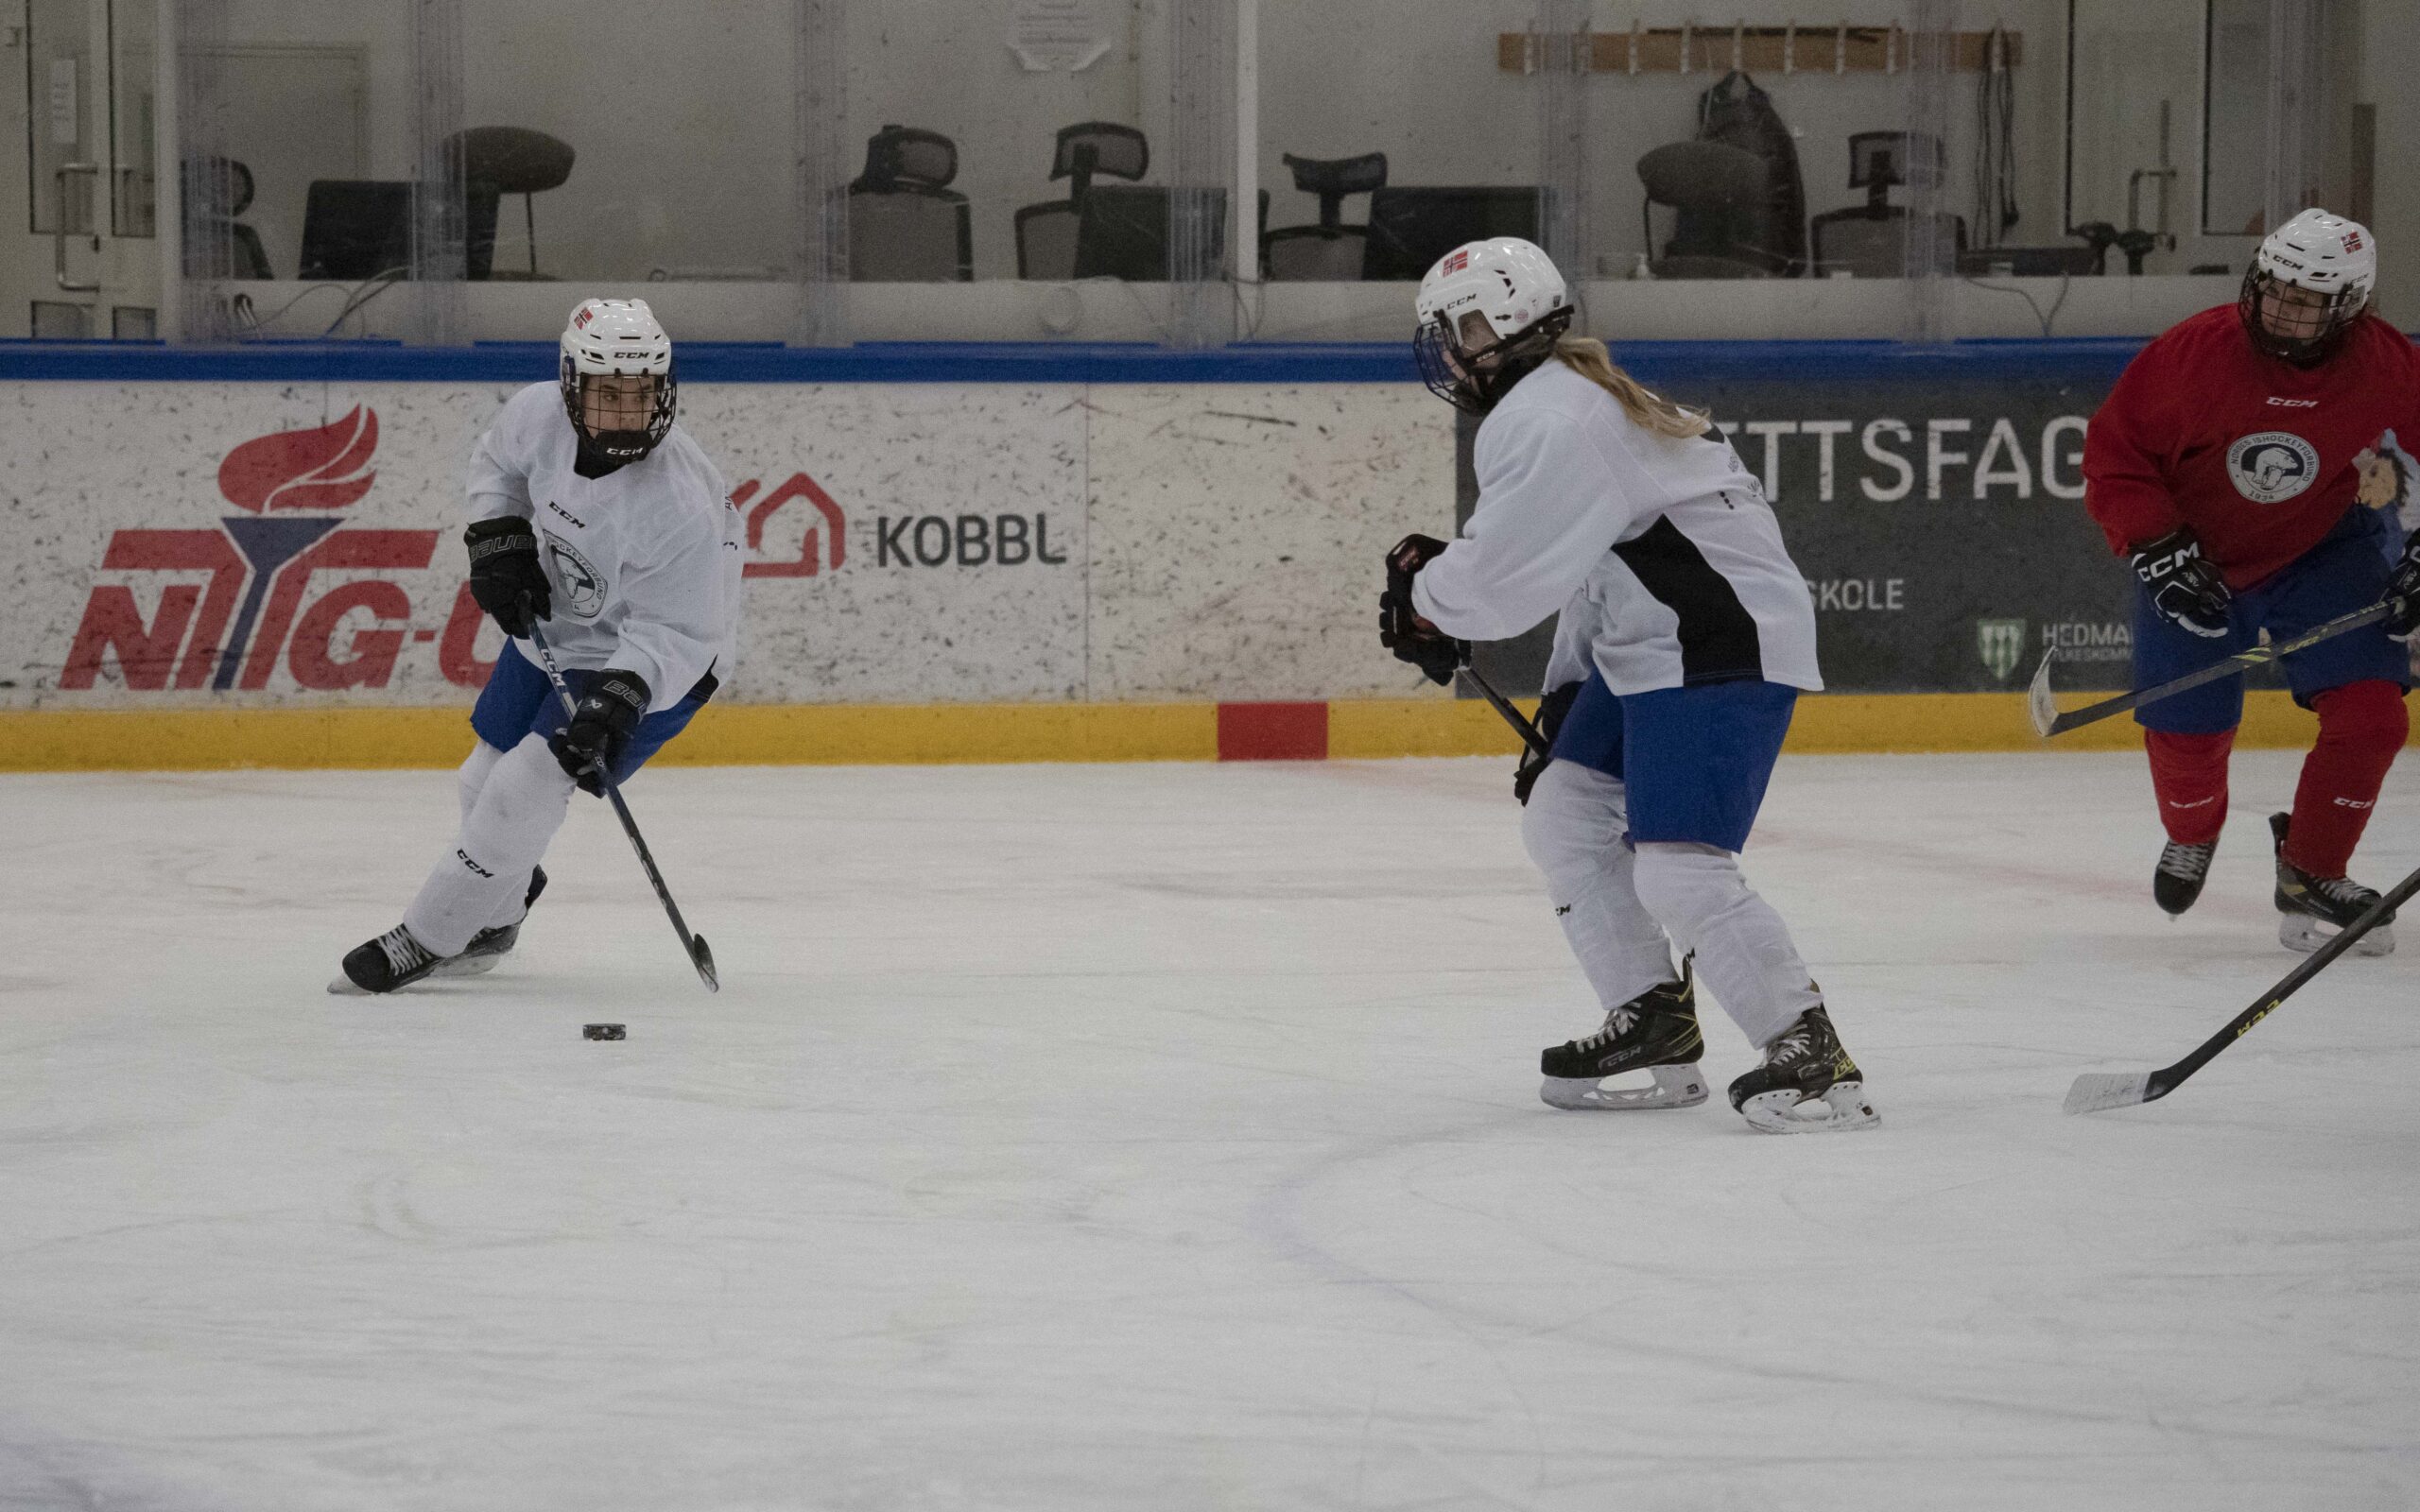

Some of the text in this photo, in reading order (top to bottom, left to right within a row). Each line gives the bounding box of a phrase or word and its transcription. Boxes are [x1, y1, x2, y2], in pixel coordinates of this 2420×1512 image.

[2273, 254, 2304, 270] CCM
[1446, 293, 1478, 310] CCM
[2266, 396, 2319, 408] CCM
[606, 447, 643, 455] CCM
[548, 501, 586, 528] CCM
[877, 513, 1067, 567] KOBBL
[2137, 541, 2200, 582] CCM
[2042, 623, 2134, 646] HEDMA
[540, 648, 566, 687] CCM
[457, 849, 493, 879] CCM
[1608, 1045, 1641, 1067] CCM
